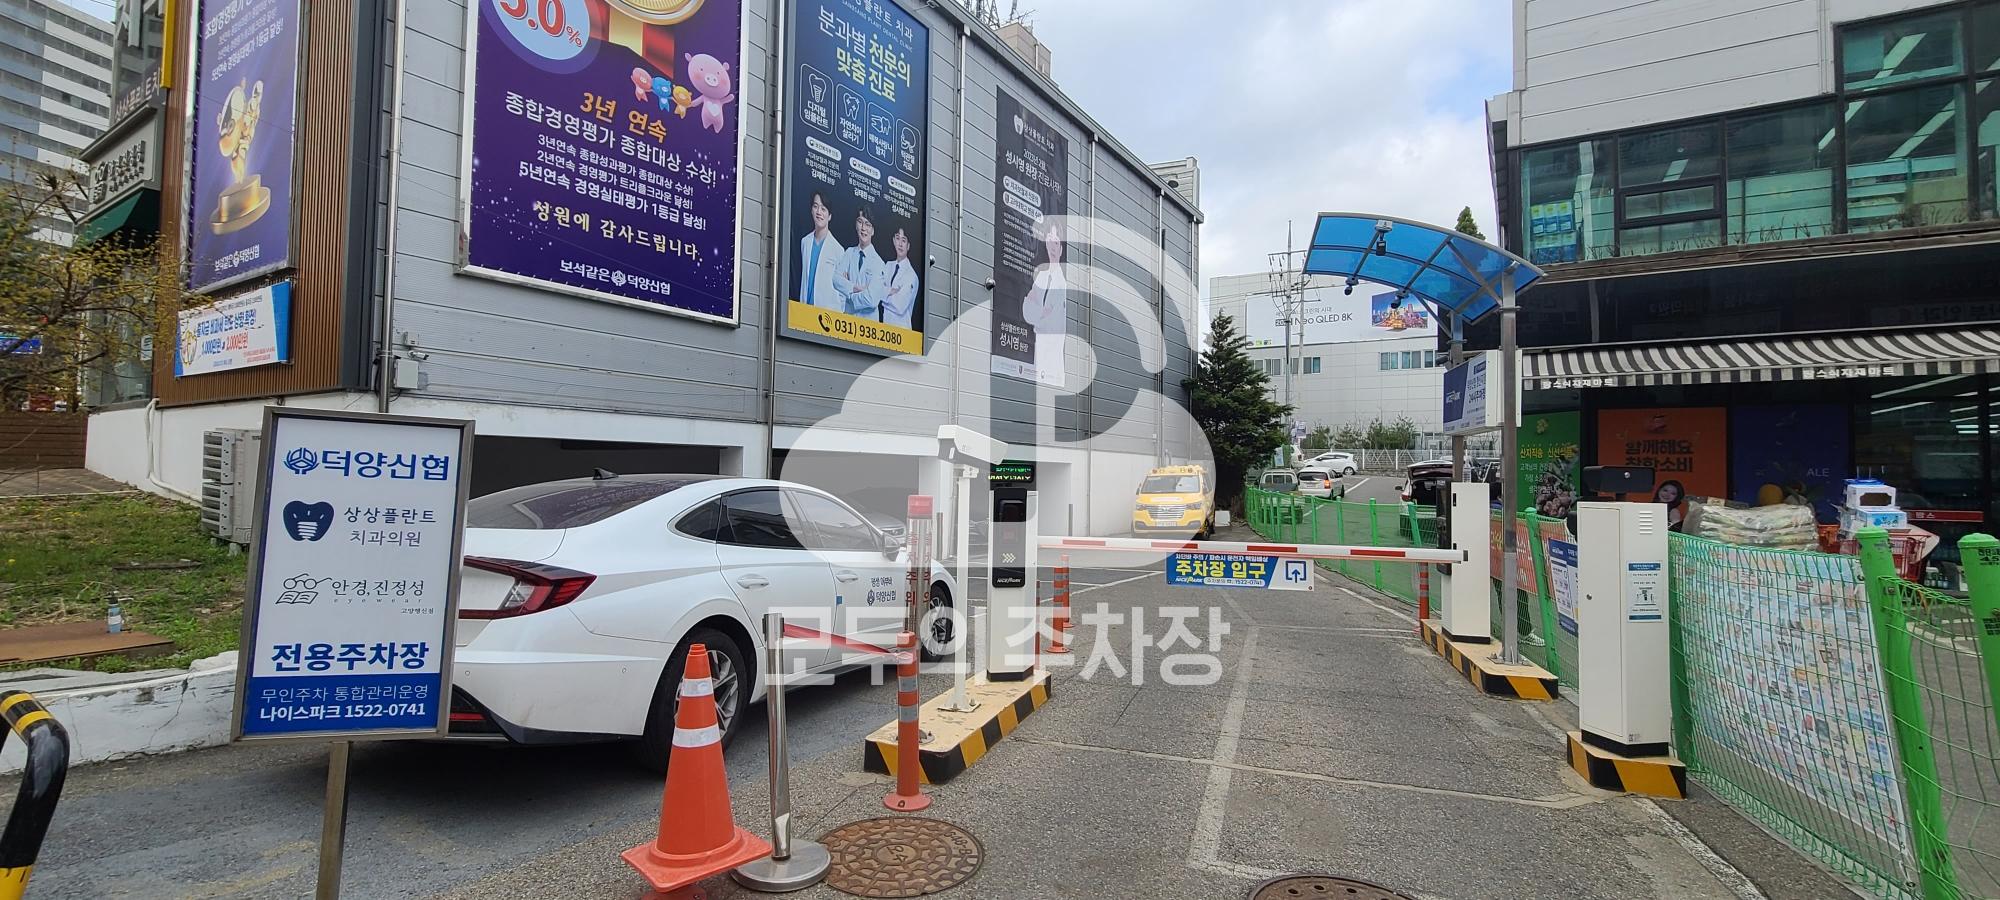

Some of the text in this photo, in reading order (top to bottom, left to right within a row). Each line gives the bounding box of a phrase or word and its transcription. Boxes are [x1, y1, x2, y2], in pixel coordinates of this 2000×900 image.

[896, 19, 913, 42] 치과
[818, 5, 910, 87] 분과별 전문의
[836, 46, 896, 102] 맞춤 진료
[580, 92, 667, 143] 3년 연속
[803, 108, 829, 129] 임플란트
[807, 101, 826, 118] 디지털
[839, 117, 862, 136] 자연치아
[842, 130, 860, 145] 살리기
[505, 91, 717, 188] 종합경영평가 종합대상 수상!
[538, 134, 694, 196] 3년연속 종합성과평가 종합대상 수상!
[1006, 150, 1025, 173] 성시영
[1026, 164, 1038, 180] 원장
[537, 150, 693, 211] 2년연속 경영평가 트리플크라운 달성!
[519, 161, 707, 231] 5년연속 경영실태평가 1등급 달성!
[533, 200, 703, 262] 성원에 감사드립니다.
[560, 259, 671, 296] 보석같은 덕양신협
[1316, 314, 1340, 323] QLED
[1342, 312, 1353, 321] 8K
[834, 319, 902, 346] 031) 938.2080
[1000, 332, 1020, 351] 성시영
[1626, 440, 1693, 455] 함께해요
[321, 450, 450, 481] 덕양신협
[343, 506, 436, 525] 상상플란트
[350, 530, 422, 547] 치과의원
[1175, 560, 1266, 579] 주차장 입구
[331, 579, 425, 598] 안경,진정성
[271, 641, 430, 672] 전용주차장
[261, 684, 428, 704] 무인주차 통합관리운영
[260, 702, 426, 721] 나이스파크 1522-0741
